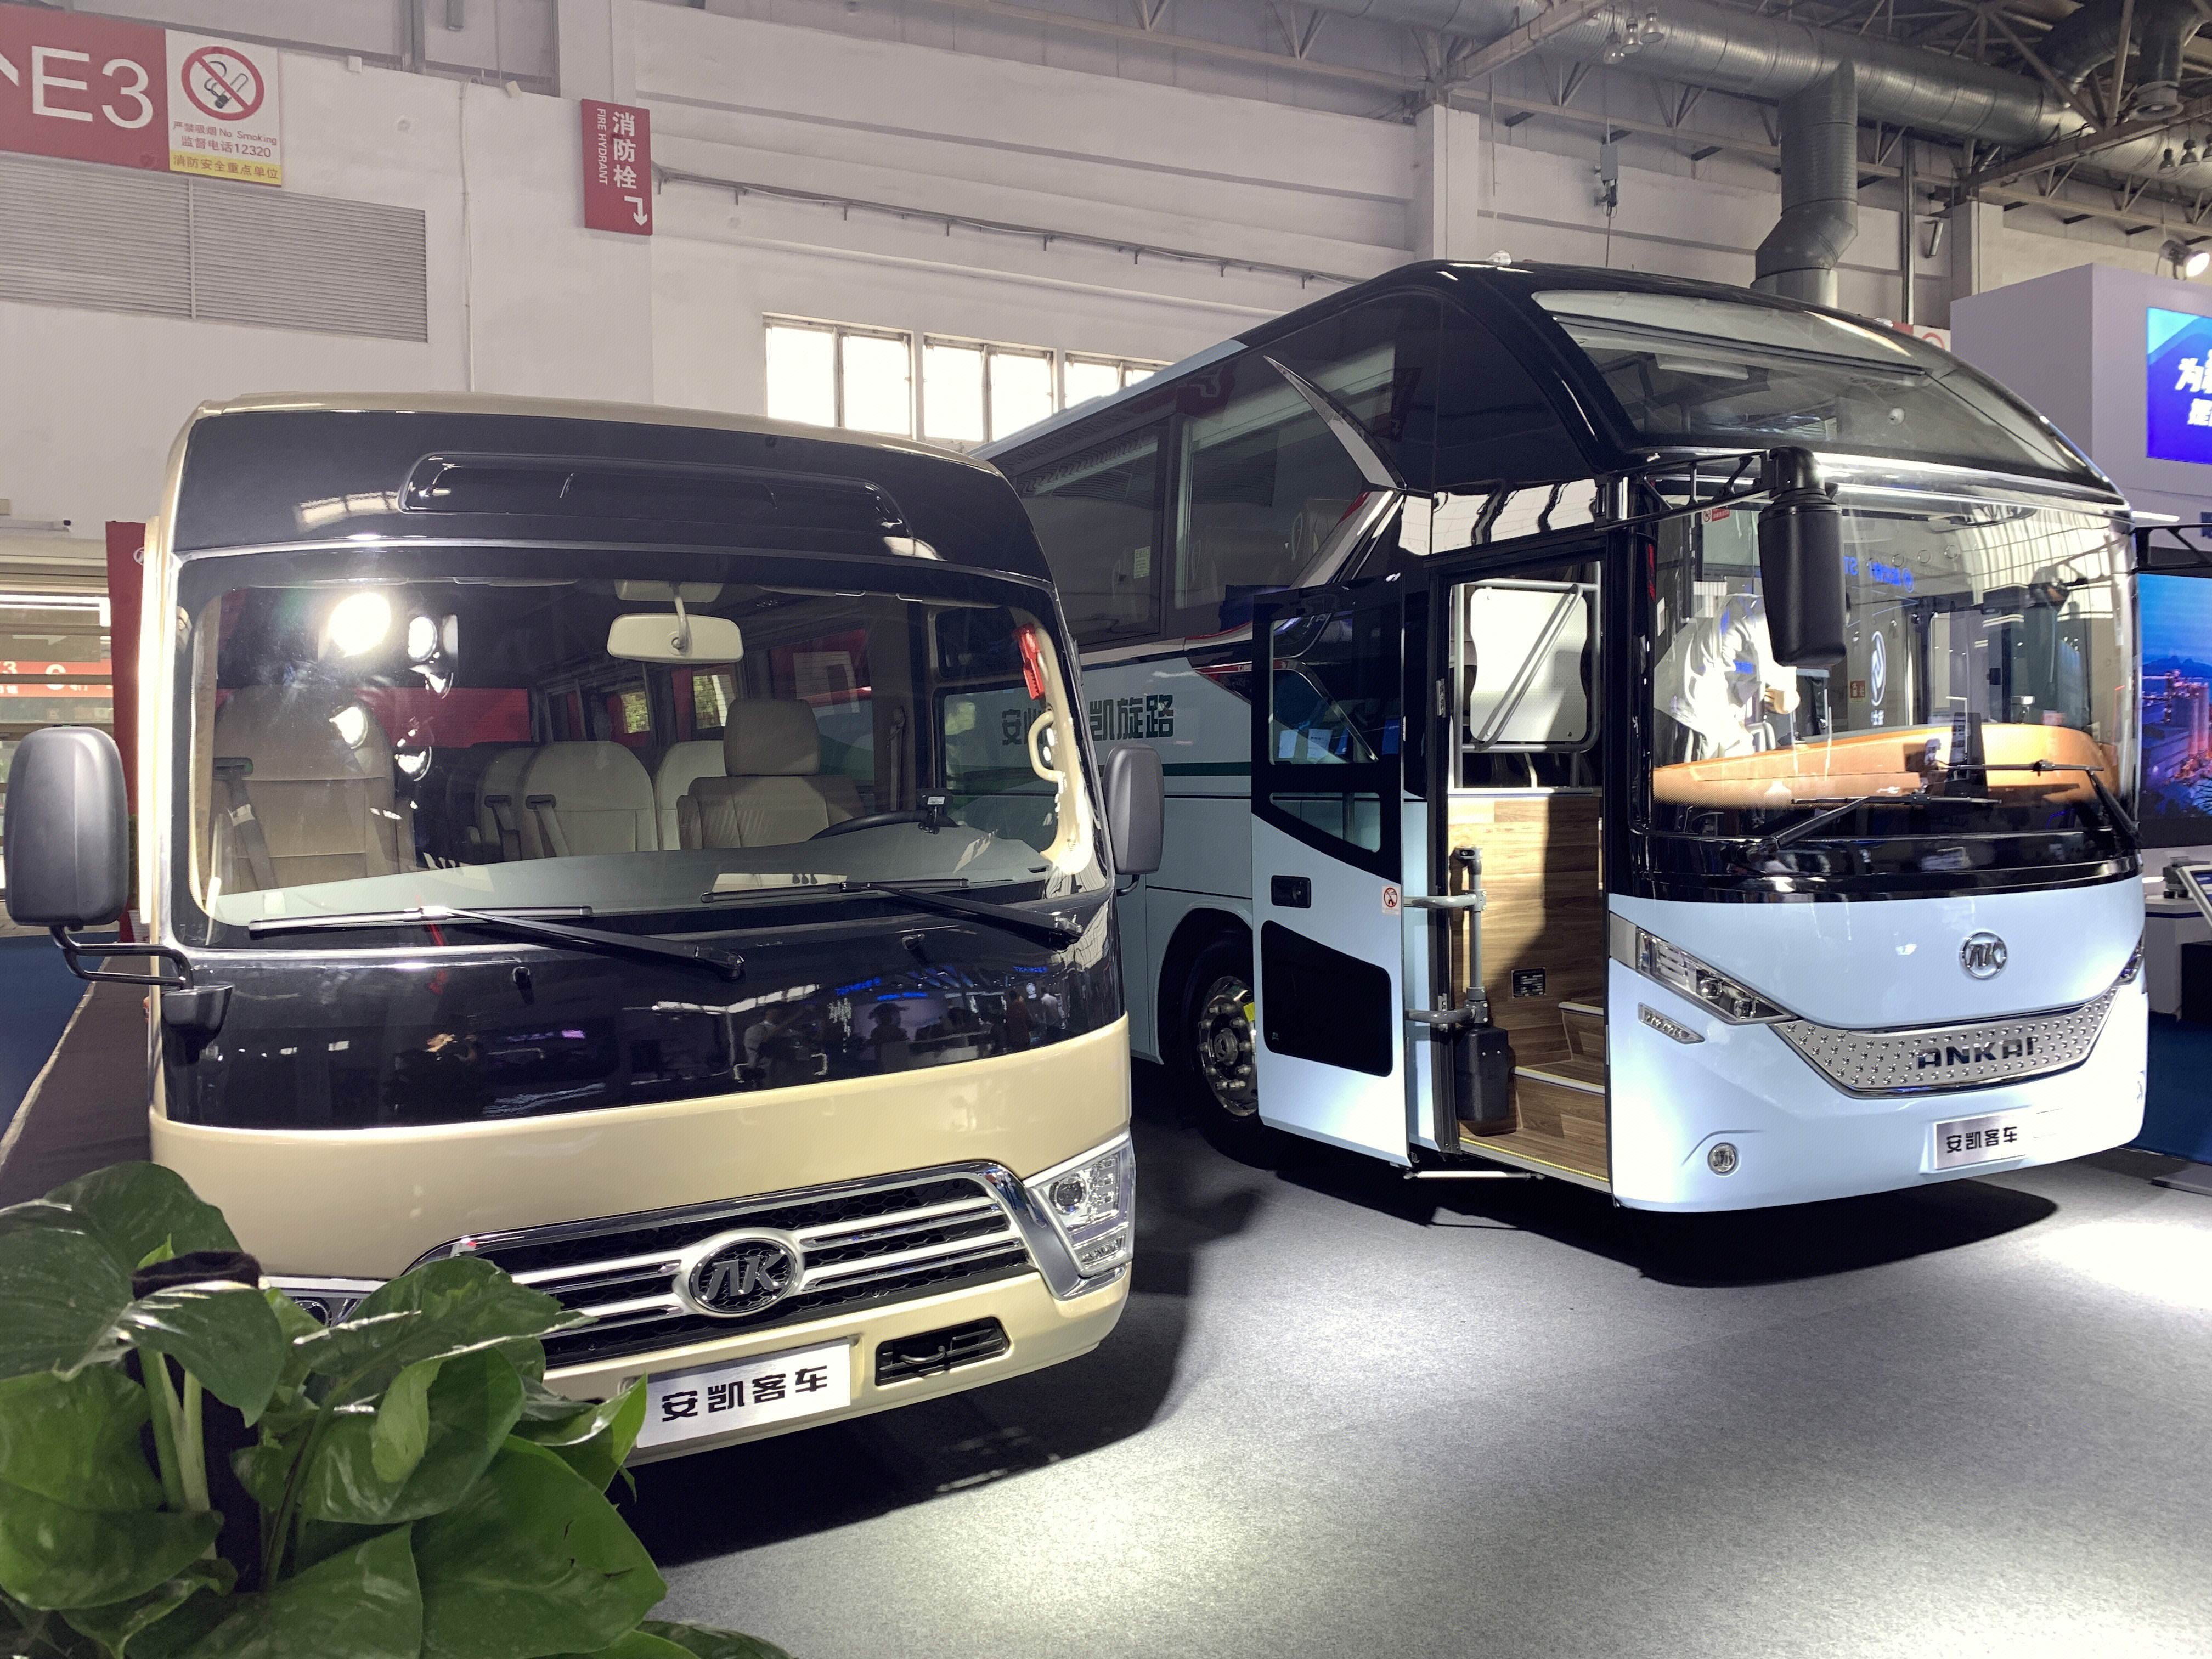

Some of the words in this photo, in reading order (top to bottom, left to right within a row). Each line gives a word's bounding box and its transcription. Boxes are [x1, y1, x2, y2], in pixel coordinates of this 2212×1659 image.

[32, 45, 154, 129] E3
[173, 121, 217, 137] 严禁吸烟
[219, 128, 232, 137] No
[237, 130, 278, 146] Smoking
[596, 108, 607, 131] FIRE
[173, 154, 279, 179] 消防安全重点单位
[597, 133, 608, 186] HYDRANT
[612, 111, 637, 189] 消防栓
[1918, 1037, 2034, 1070] ANKAI
[1946, 1126, 2018, 1153] 安凯客车
[662, 1365, 828, 1423] 安凯客车
